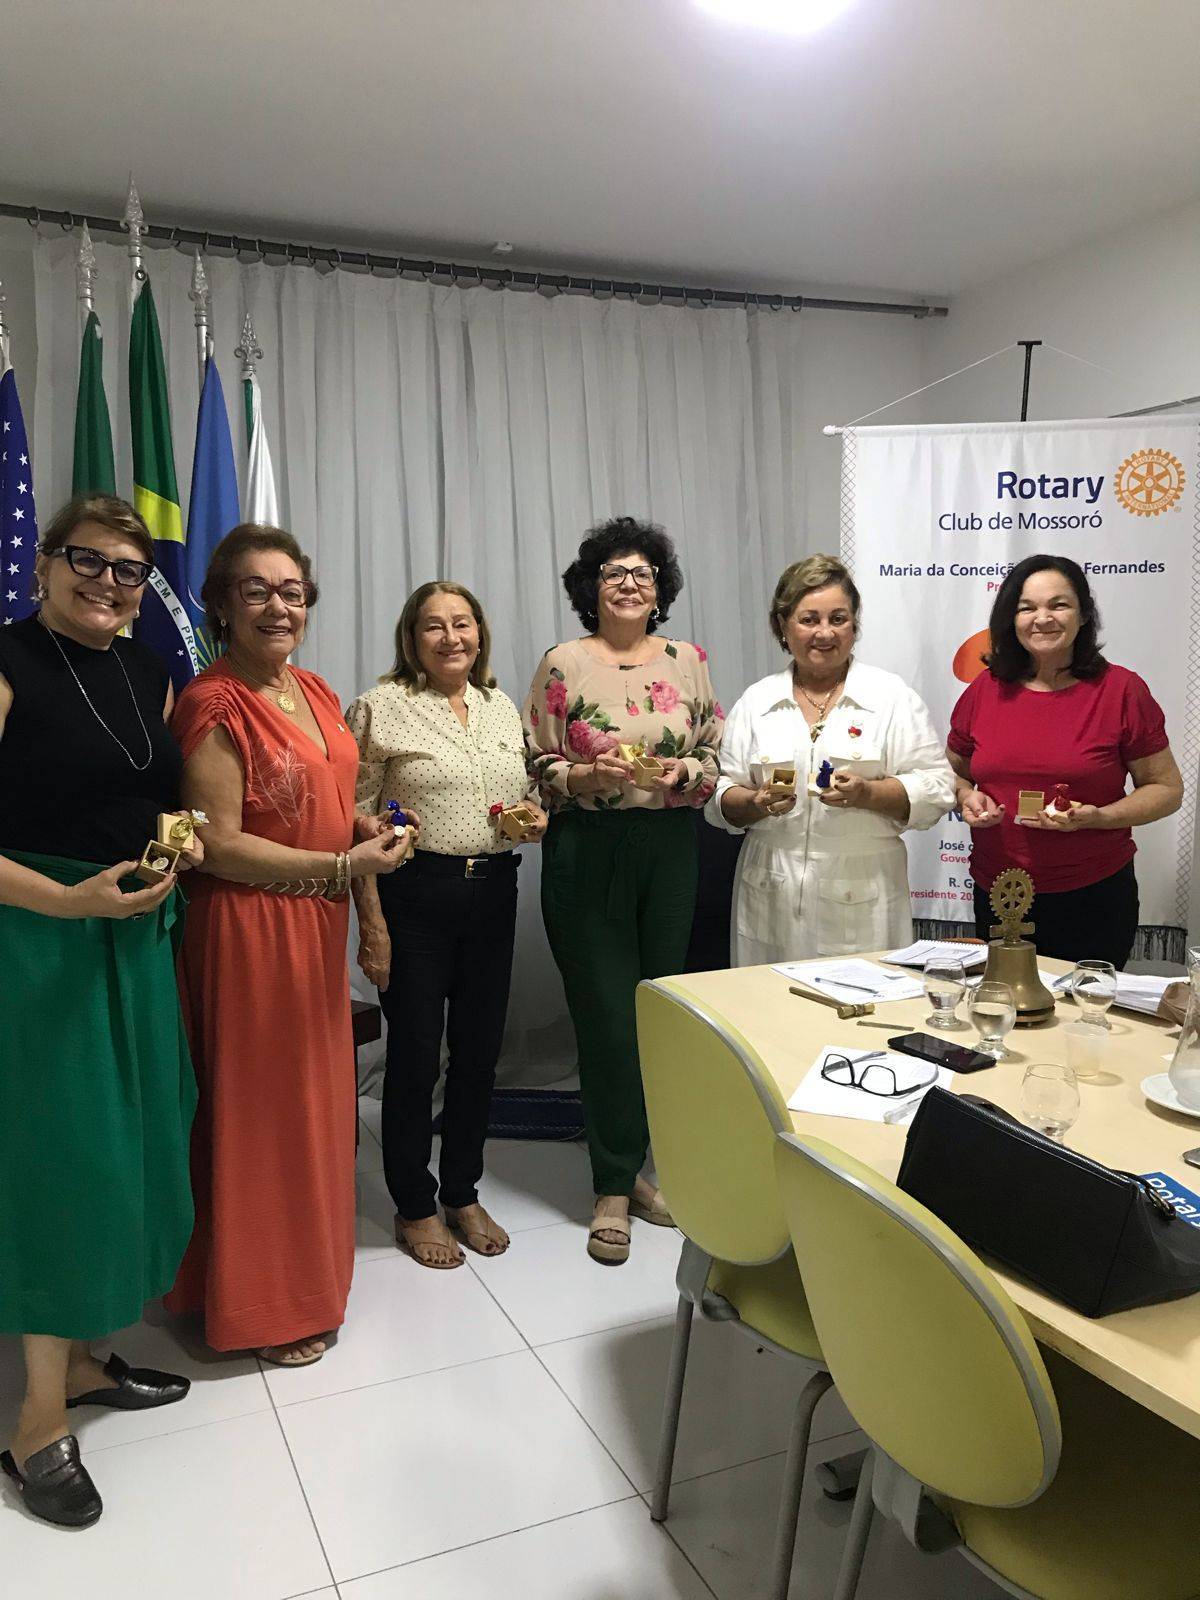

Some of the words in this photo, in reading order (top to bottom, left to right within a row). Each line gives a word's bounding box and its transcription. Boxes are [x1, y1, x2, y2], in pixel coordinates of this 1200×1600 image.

[998, 471, 1105, 504] Rotary
[939, 513, 983, 531] Club
[988, 512, 1013, 530] de
[1018, 510, 1103, 530] Mossoró
[880, 564, 922, 577] Maria
[926, 564, 945, 577] da
[950, 562, 1014, 578] Conceiçã
[1084, 560, 1165, 574] Fernandes
[149, 569, 171, 599] DEM
[172, 606, 182, 617] E
[939, 840, 965, 851] José
[949, 878, 960, 888] R.
[964, 879, 975, 889] G
[910, 890, 957, 900] residente
